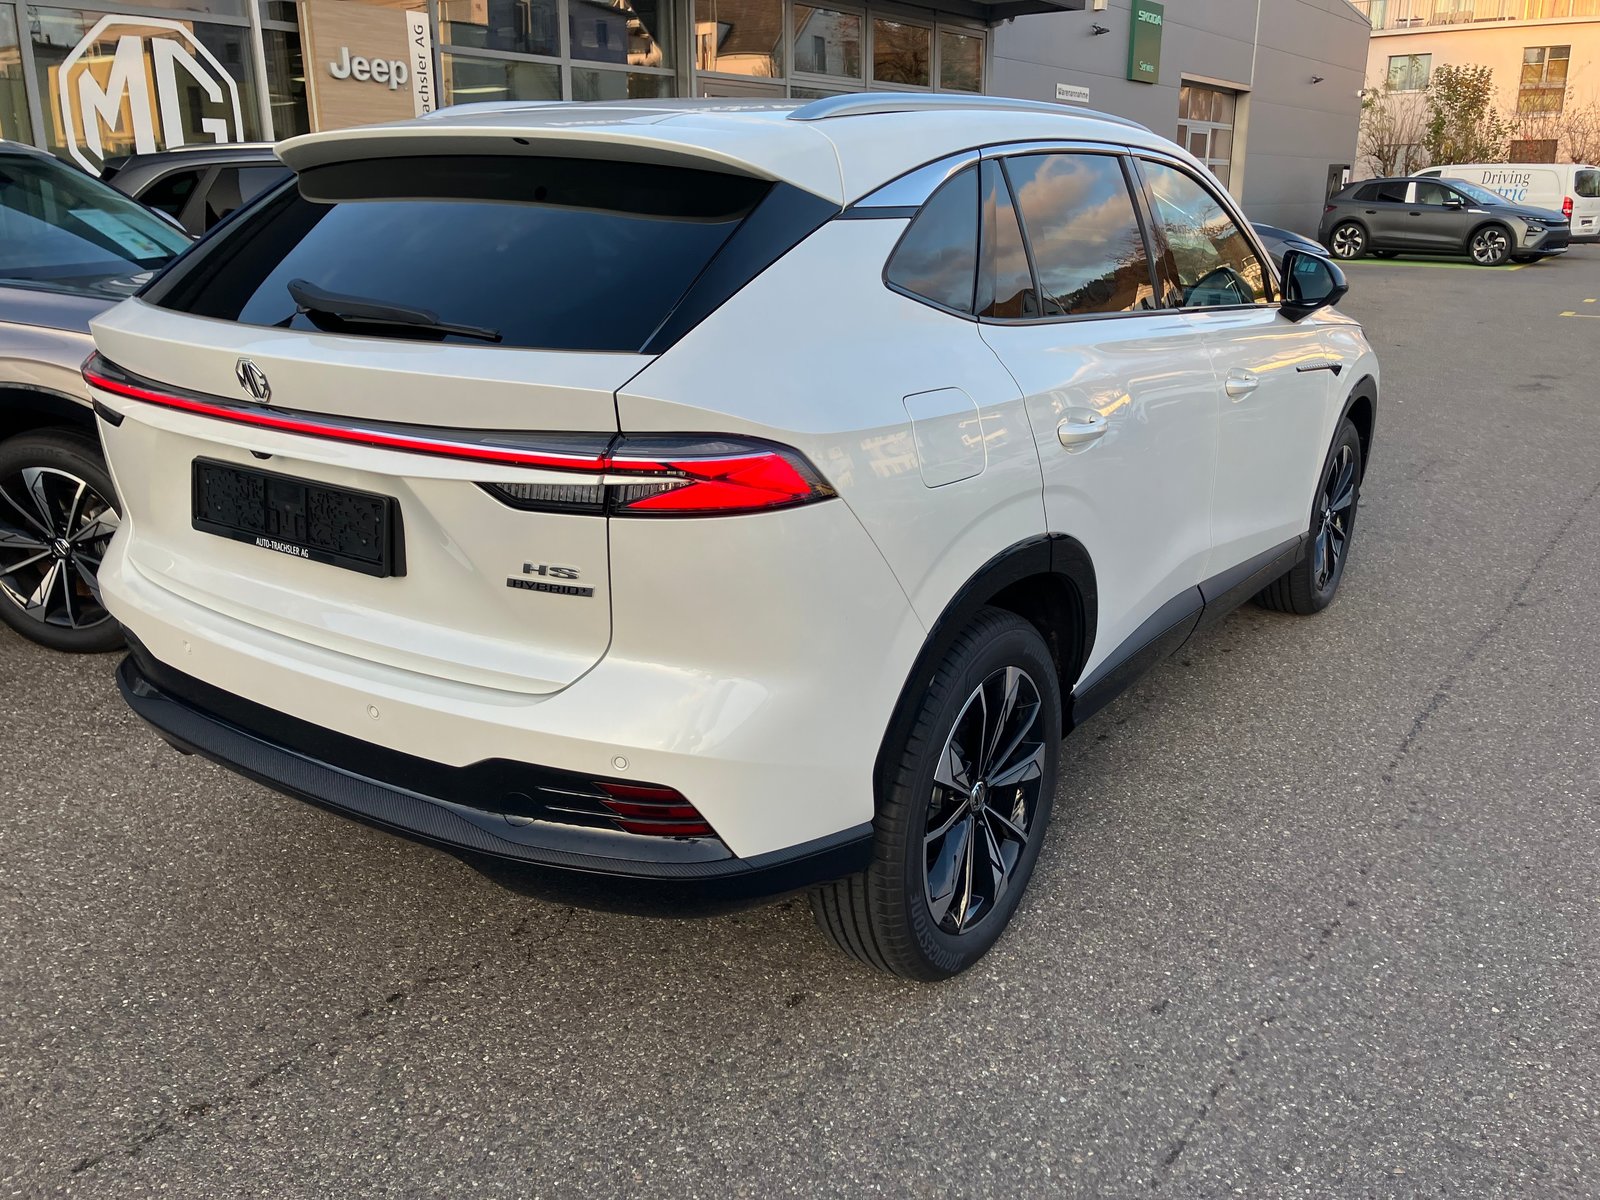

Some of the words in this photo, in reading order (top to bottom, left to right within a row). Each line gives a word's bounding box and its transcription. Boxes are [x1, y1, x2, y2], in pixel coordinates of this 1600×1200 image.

[414, 24, 425, 48] AG
[329, 46, 409, 91] Jeep
[78, 35, 229, 161] MG
[1481, 170, 1531, 188] Driving
[236, 359, 270, 401] MG
[255, 537, 300, 556] AUTO-TRACHSLER
[300, 548, 309, 558] AG
[522, 562, 580, 580] HS
